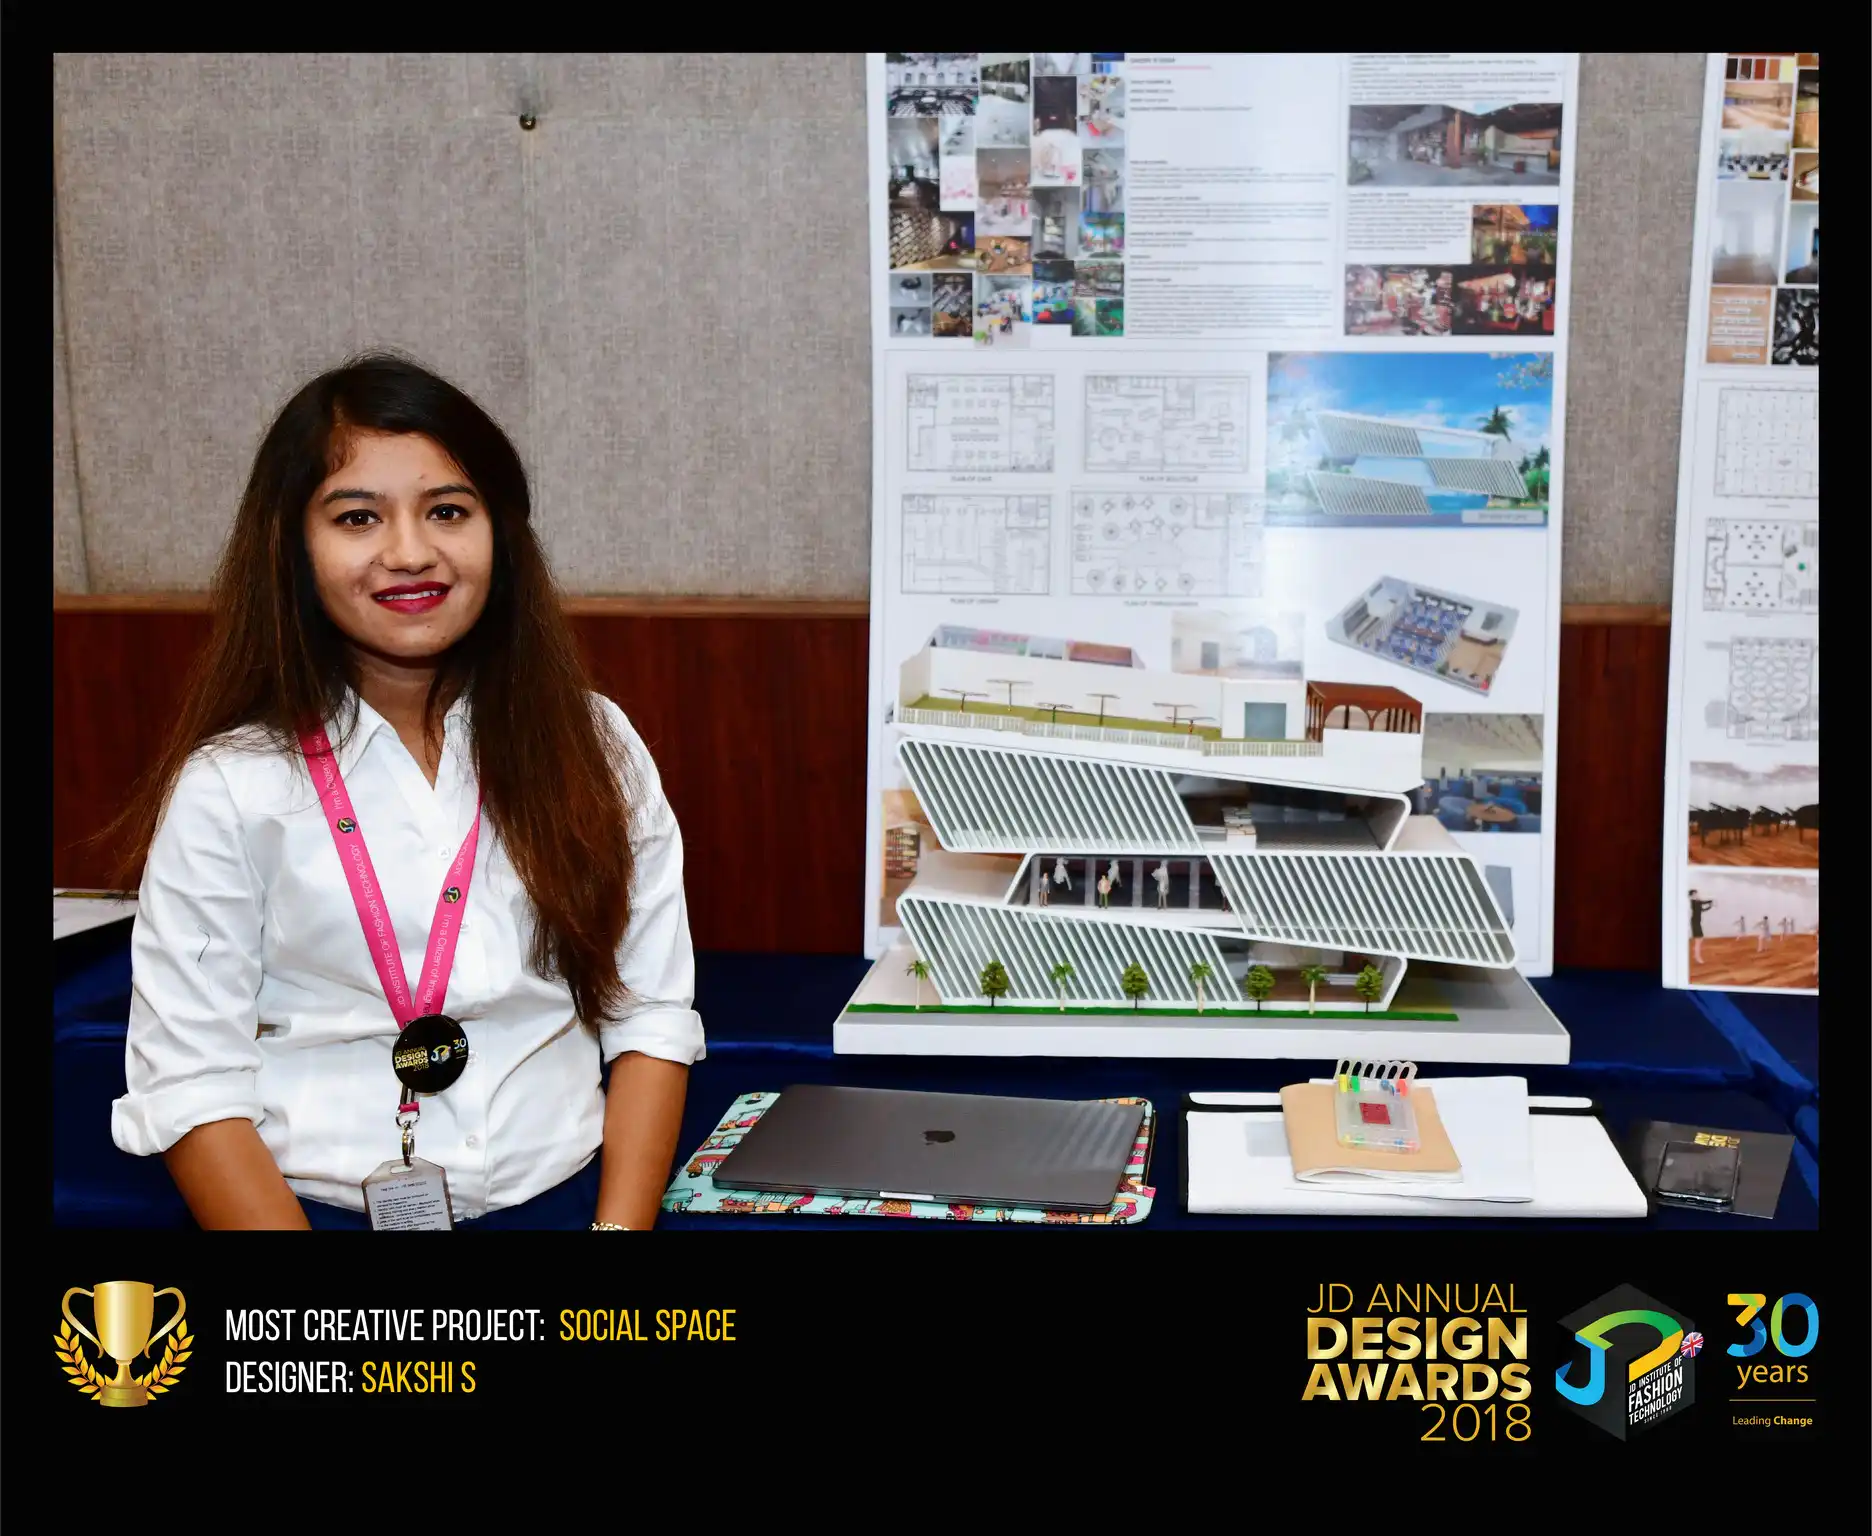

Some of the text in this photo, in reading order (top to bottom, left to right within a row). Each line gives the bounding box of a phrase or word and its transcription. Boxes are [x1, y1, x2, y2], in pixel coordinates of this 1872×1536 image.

[452, 1037, 467, 1050] 30
[394, 1050, 428, 1064] DESIGN
[395, 1057, 429, 1070] AWARDS
